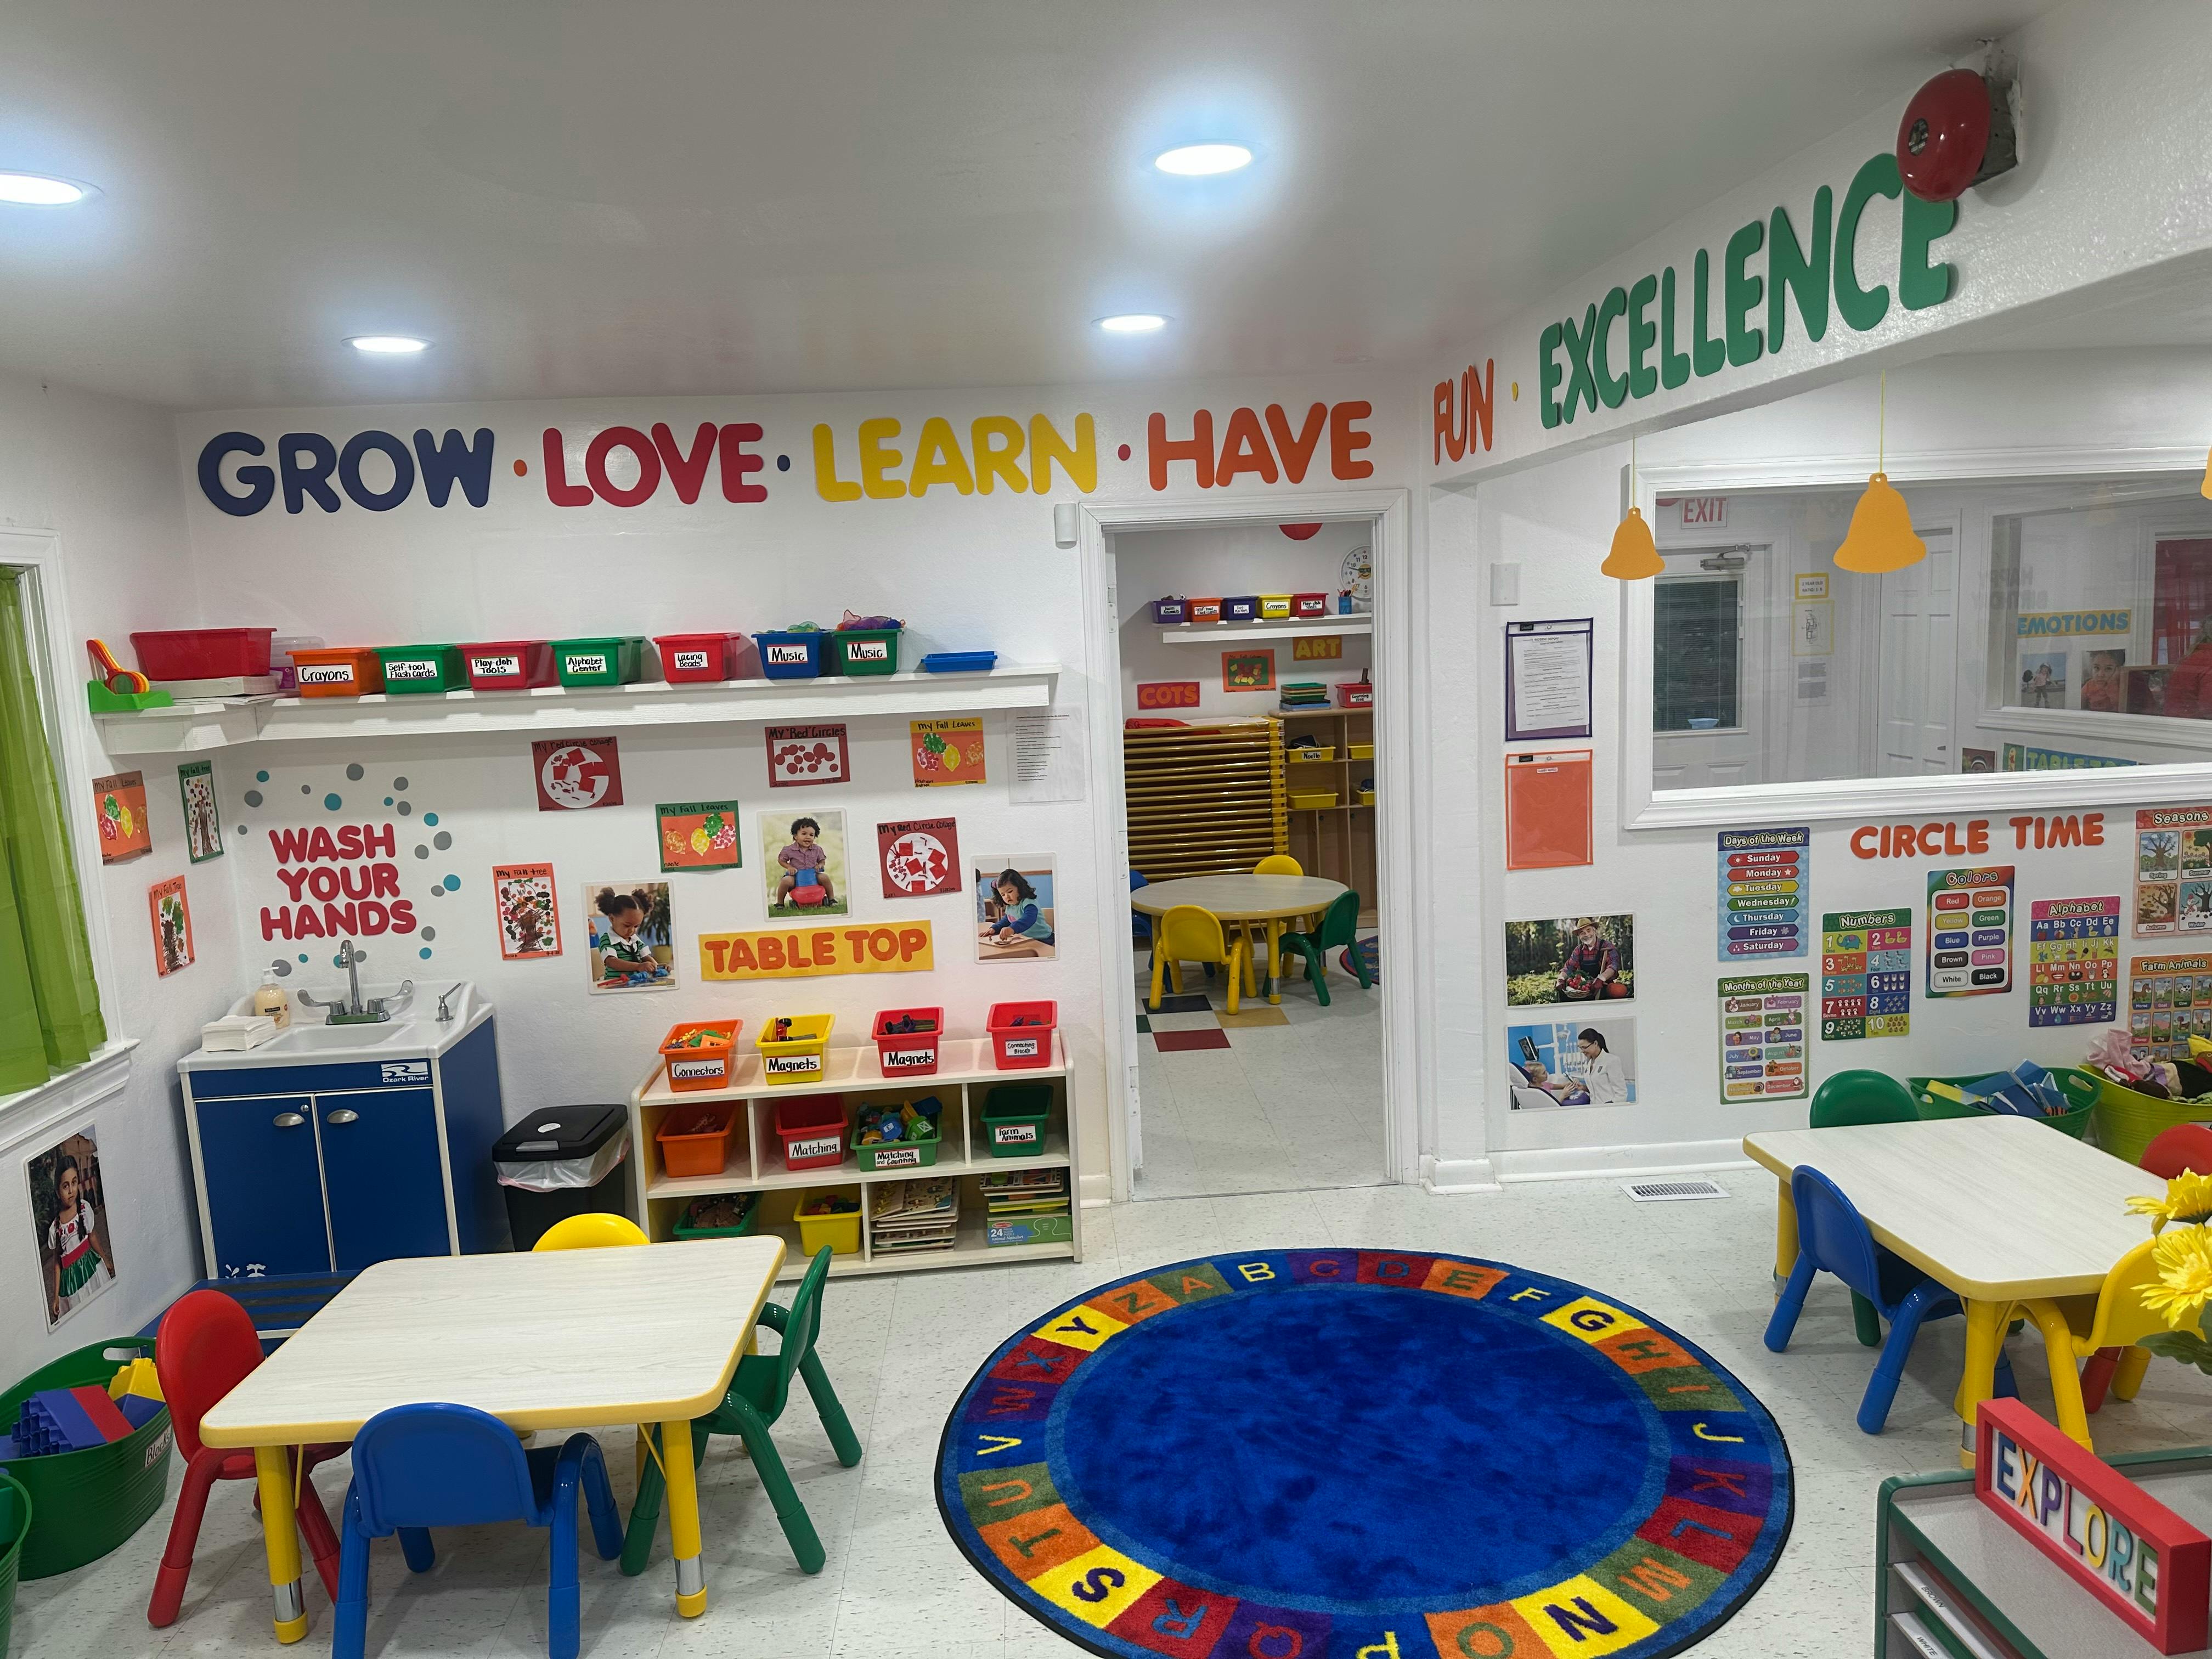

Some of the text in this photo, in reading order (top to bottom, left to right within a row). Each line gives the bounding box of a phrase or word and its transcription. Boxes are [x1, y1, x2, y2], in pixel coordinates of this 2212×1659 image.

[1539, 153, 1954, 430] EXCELLENCE
[1434, 358, 1494, 466] FUN
[198, 399, 1374, 517] GROW LOVE LEARN HAVE
[1683, 496, 1727, 523] EXIT
[2017, 611, 2129, 636] EMOTIONS
[771, 647, 805, 662] Music
[850, 642, 883, 659] Music
[1295, 637, 1340, 658] ART
[481, 666, 506, 674] Tools
[568, 657, 603, 667] Alphabet
[572, 664, 602, 673] Center
[301, 667, 349, 682] Crayons
[390, 670, 411, 679] Flash
[1140, 685, 1197, 706] COTS
[769, 727, 784, 739] My
[917, 720, 975, 731] My Fall Leaves
[1304, 752, 1321, 760] Noelle
[660, 806, 676, 816] My
[680, 805, 696, 813] Fall
[2153, 811, 2210, 825] Seasons
[268, 822, 396, 864] WASH
[1724, 832, 1803, 847] Days of the Week
[1849, 812, 2104, 860] CIRCLE TIME
[1747, 854, 1781, 863] Sunday
[495, 870, 511, 878] My
[1746, 868, 1782, 878] Monday
[1945, 870, 1999, 886] Colors
[276, 862, 400, 902] YOUR
[1745, 883, 1782, 893] Tuesday
[1737, 897, 1790, 907] Wednesday
[1977, 895, 2002, 904] Orange
[2048, 900, 2104, 917] Alphabet
[259, 899, 417, 941] HANDS
[1742, 912, 1784, 922] Thursday
[1839, 913, 1896, 929] Numbers
[2036, 916, 2114, 929] Aa Bb Cc Dd Ee
[1750, 927, 1778, 936] Friday
[1871, 932, 1881, 946] 2
[1978, 933, 1999, 941] Purple
[1743, 941, 1784, 951] Saturday
[1826, 935, 1833, 949] 1
[704, 928, 928, 974] TABLE TOP
[1825, 957, 1835, 971] 3
[1871, 953, 1880, 967] 4
[2035, 960, 2113, 973] Ll Mm Nn Oo Pp
[2141, 958, 2208, 972] Farm Animals
[1723, 977, 1804, 993] Months of the Year
[1825, 978, 1836, 992] 5
[1870, 975, 1881, 989] 6
[2035, 981, 2112, 995] Qq Rr Ss Tt Uu
[1825, 1000, 1835, 1014] 7
[1869, 996, 1879, 1009] 8
[2035, 1002, 2112, 1015] Vv Ww Xx Yy Zz
[1825, 1021, 1835, 1035] 9
[1867, 1016, 1884, 1030] 10
[768, 1057, 817, 1073] Magnets
[888, 1051, 935, 1066] Magnets
[674, 1063, 724, 1077] Connectors
[1001, 1132, 1034, 1142] Animals
[792, 1142, 837, 1156] Matching
[877, 1151, 914, 1160] Matching
[991, 1228, 1003, 1238] 24
[1238, 1262, 1277, 1283] B
[1309, 1260, 1341, 1278] C
[1375, 1260, 1411, 1279] D
[1182, 1276, 1215, 1295] A
[1441, 1268, 1485, 1291] E
[1508, 1286, 1552, 1302] F
[1112, 1291, 1153, 1315] Z
[1054, 1316, 1099, 1337] Y
[1570, 1308, 1616, 1333] G
[1617, 1339, 1671, 1362] H
[1015, 1350, 1067, 1373] X
[1667, 1384, 1711, 1393] I
[987, 1386, 1037, 1415] W
[1692, 1422, 1745, 1444] J
[976, 1434, 1023, 1457] V
[1694, 1468, 1746, 1498] K
[981, 1479, 1033, 1508] U
[1671, 1518, 1735, 1541] L
[1996, 1430, 2159, 1617] EXPLORE
[1008, 1527, 1061, 1559] T
[1071, 1566, 1126, 1603] S
[1617, 1556, 1692, 1603] M
[1921, 1586, 1945, 1608] BROWN
[1151, 1598, 1209, 1640] R
[1542, 1596, 1620, 1643] N
[1248, 1620, 1304, 1659] Q
[1456, 1621, 1515, 1659] O
[1916, 1636, 1938, 1656] WHITE
